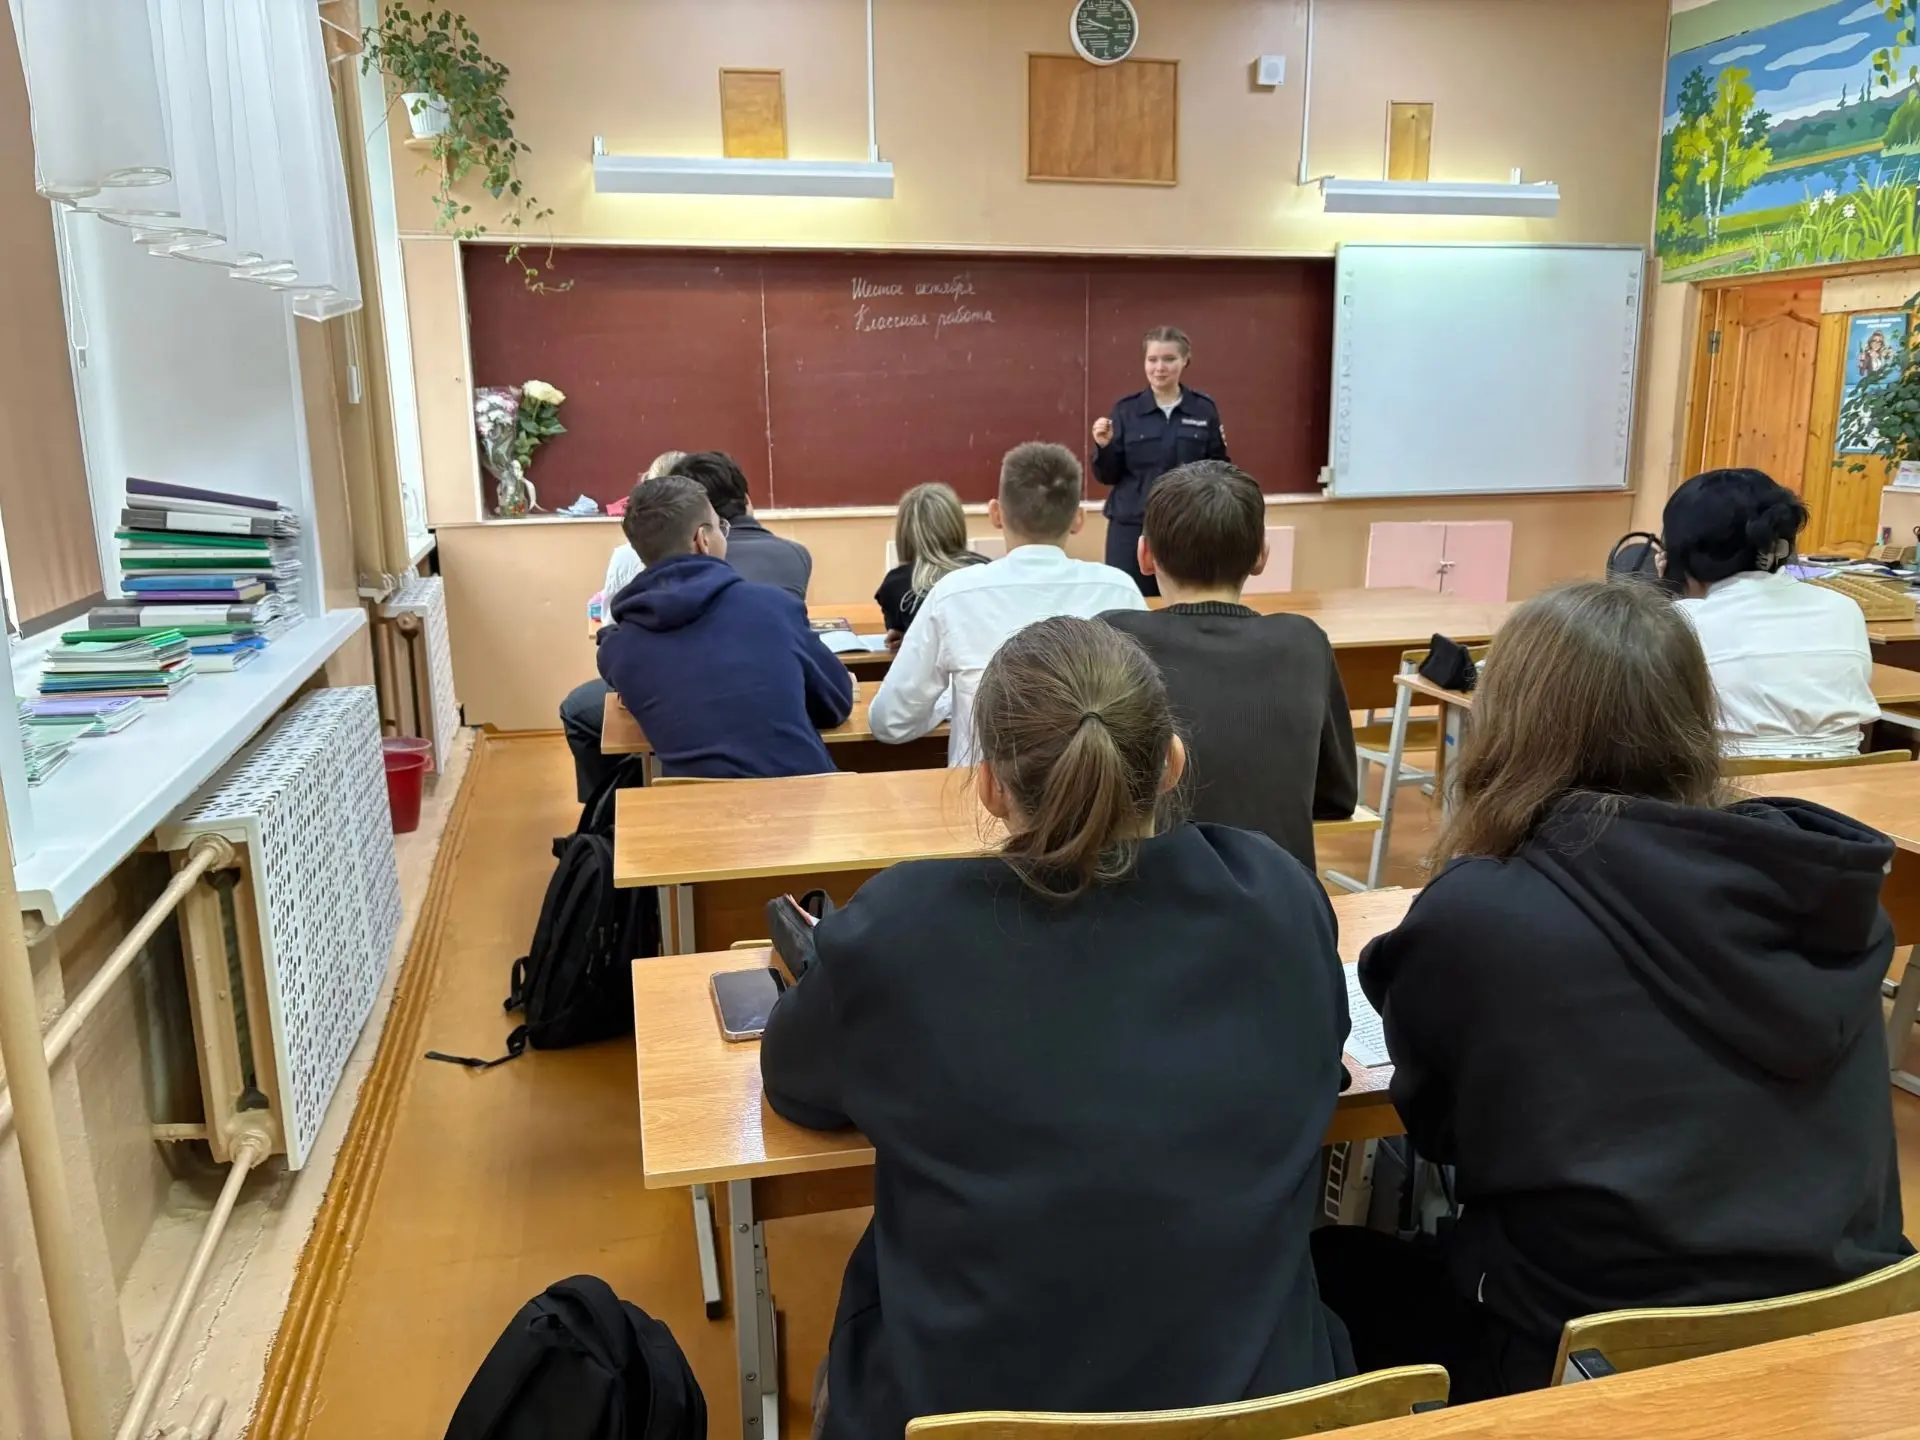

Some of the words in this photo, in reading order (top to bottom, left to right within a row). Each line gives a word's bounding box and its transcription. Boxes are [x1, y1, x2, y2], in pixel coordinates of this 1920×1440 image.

[852, 277, 904, 300] Шестое
[855, 304, 928, 332] Классная
[934, 305, 995, 340] работа
